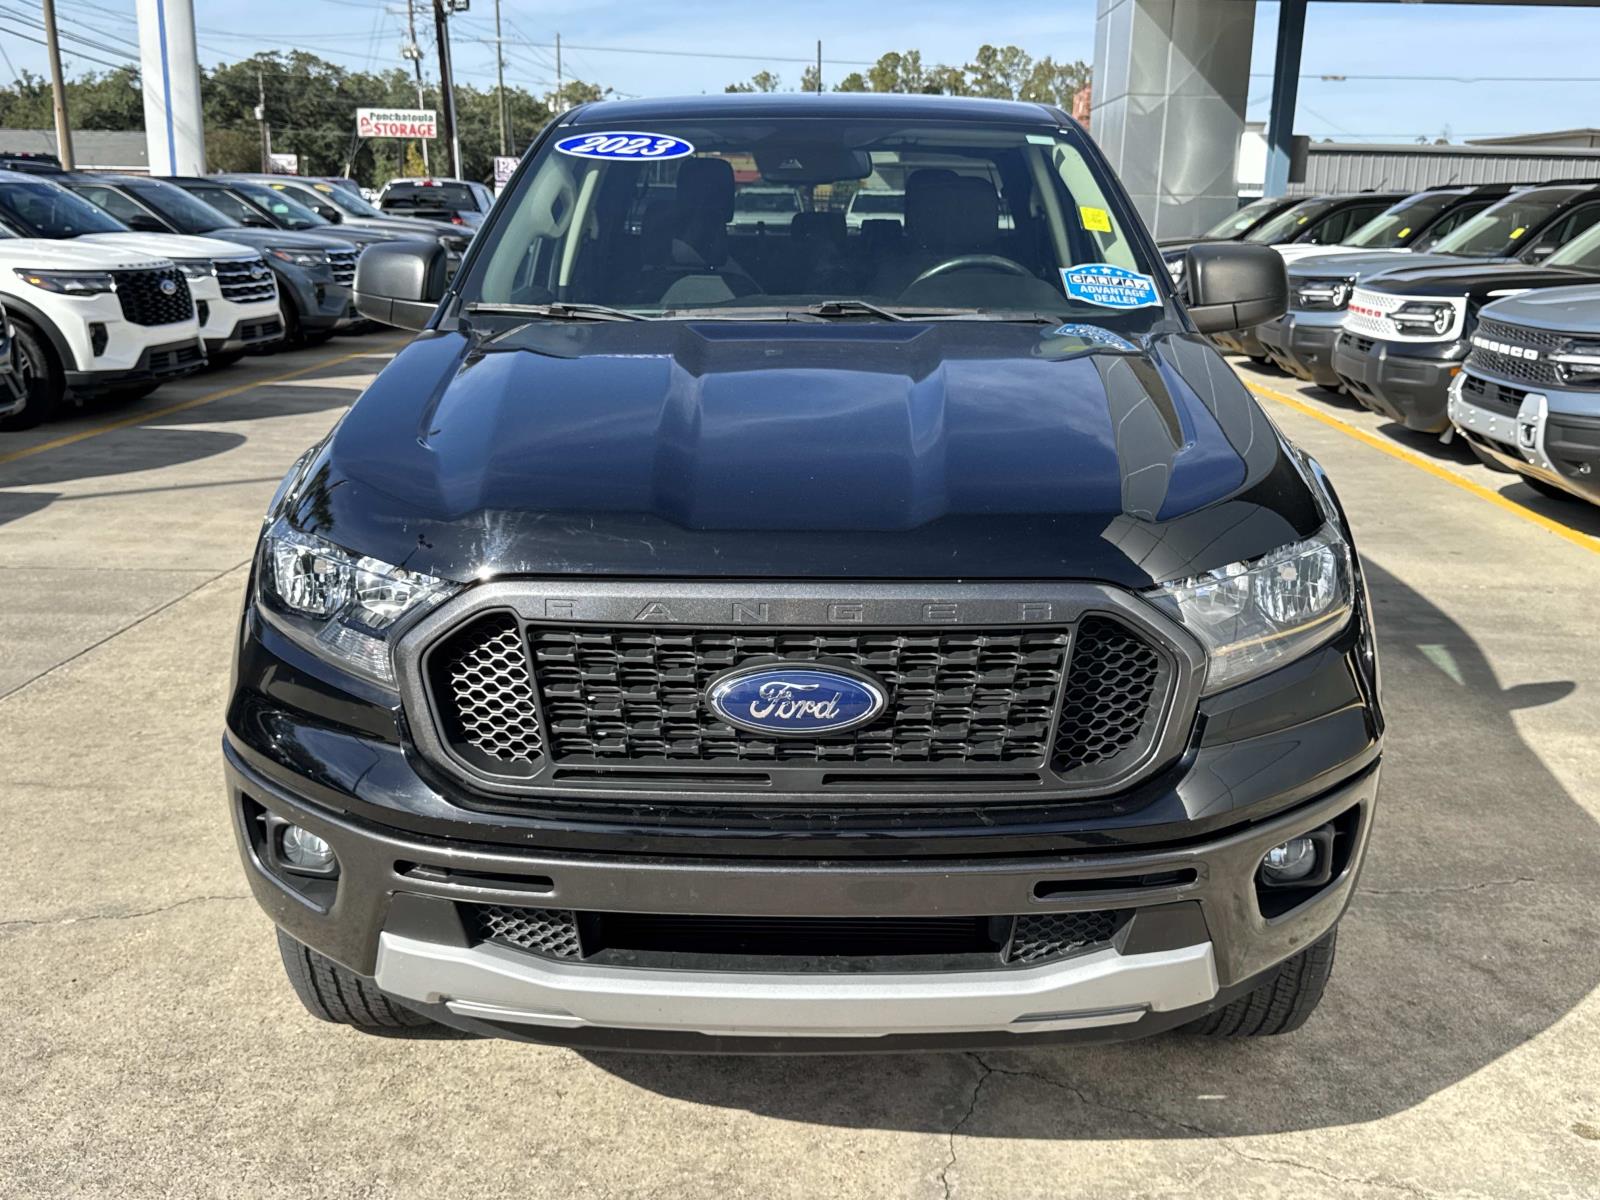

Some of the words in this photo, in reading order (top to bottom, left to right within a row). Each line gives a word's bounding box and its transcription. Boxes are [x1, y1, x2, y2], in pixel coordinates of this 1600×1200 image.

[370, 112, 433, 122] Ponchatoula
[374, 122, 433, 135] STORAGE
[570, 136, 676, 155] 2023
[1069, 274, 1150, 290] CARFAX
[1080, 285, 1146, 297] ADVANTAGE
[1094, 293, 1138, 304] DEALER
[1472, 336, 1539, 360] BRONCO
[544, 599, 1052, 623] RANGER
[749, 681, 842, 719] Ford
